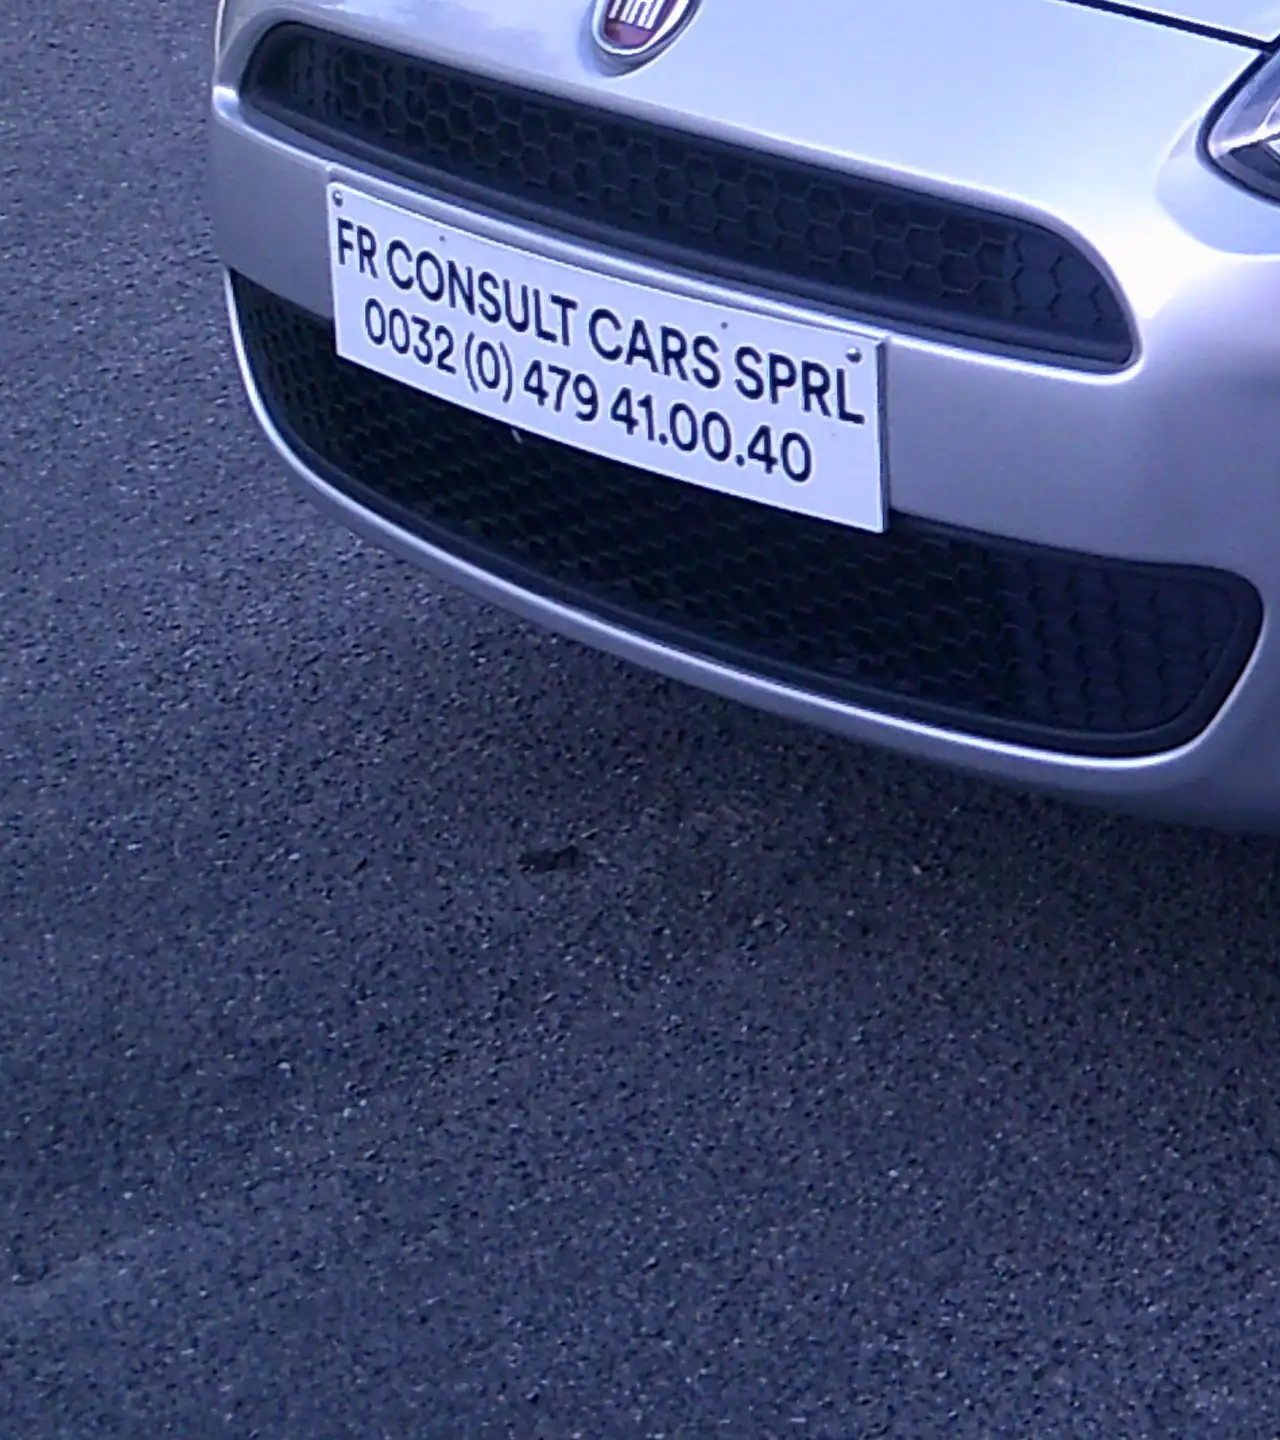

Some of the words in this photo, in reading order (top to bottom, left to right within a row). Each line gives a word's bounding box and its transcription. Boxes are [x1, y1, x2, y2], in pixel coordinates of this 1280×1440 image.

[336, 217, 380, 279] FR
[385, 239, 579, 347] CONSULT
[587, 308, 722, 389] CARS
[734, 346, 866, 425] SPRL
[522, 359, 600, 422] 479
[610, 386, 812, 483] 41.00.40
